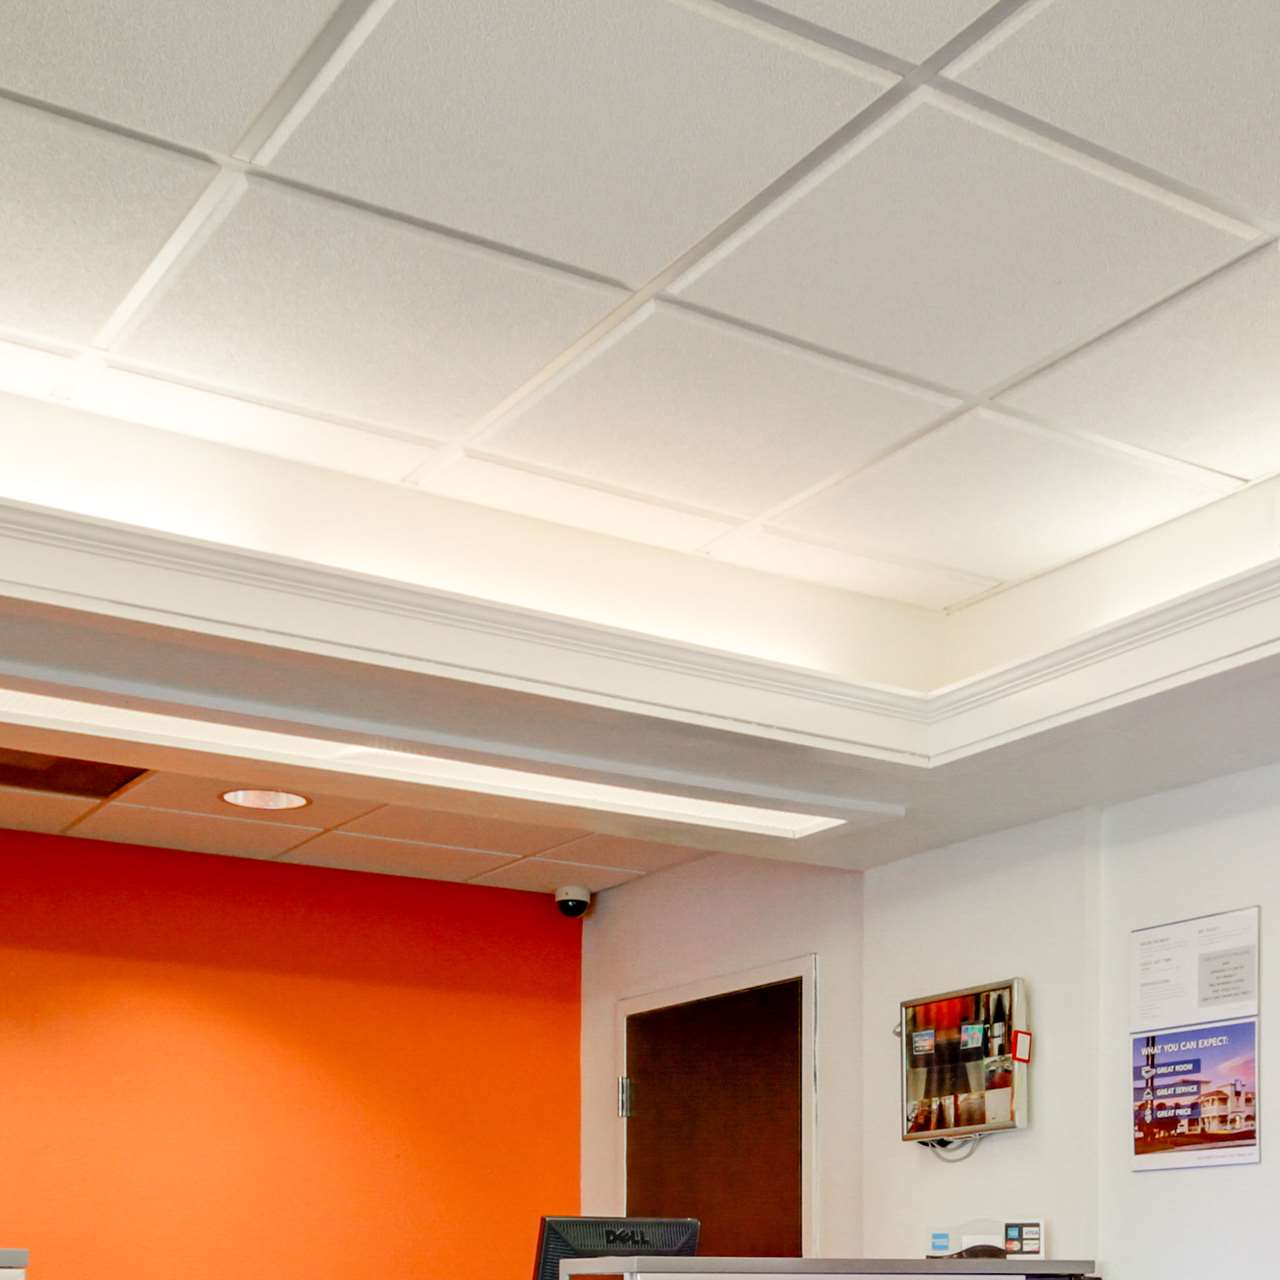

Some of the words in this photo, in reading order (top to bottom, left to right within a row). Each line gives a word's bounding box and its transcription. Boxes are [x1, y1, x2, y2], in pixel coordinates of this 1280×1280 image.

[1141, 1045, 1162, 1056] WHAT
[1164, 1043, 1178, 1052] YOU
[1180, 1040, 1197, 1050] CAN
[605, 1228, 650, 1245] DELL
